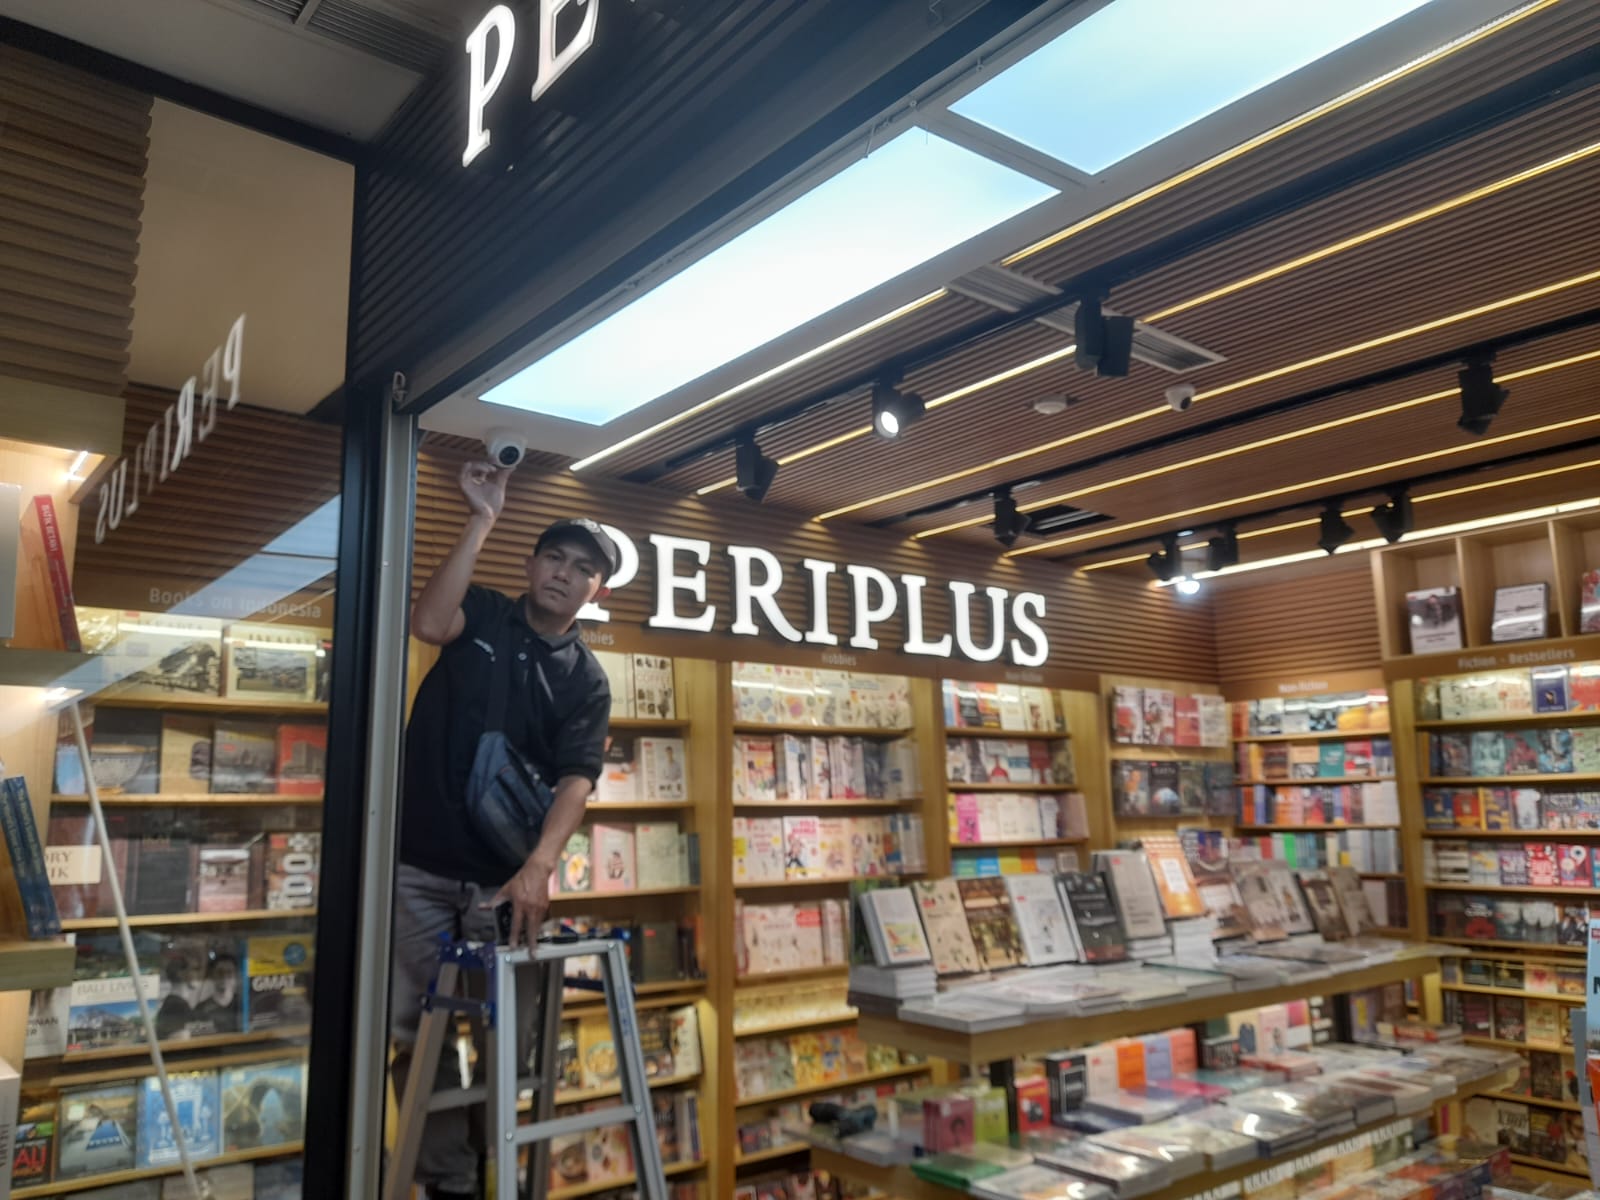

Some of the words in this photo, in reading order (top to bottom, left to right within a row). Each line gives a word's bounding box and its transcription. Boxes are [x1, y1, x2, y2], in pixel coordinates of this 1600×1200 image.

[462, 0, 635, 168] PE
[149, 588, 201, 607] Books
[212, 597, 233, 609] on
[240, 597, 322, 619] Indonesia
[575, 524, 1050, 668] PERIPLUS
[580, 631, 615, 646] bbies
[1458, 655, 1496, 669] Fiction
[110, 978, 150, 992] LIVG
[252, 974, 295, 992] GMAT
[13, 1144, 47, 1171] ALI
